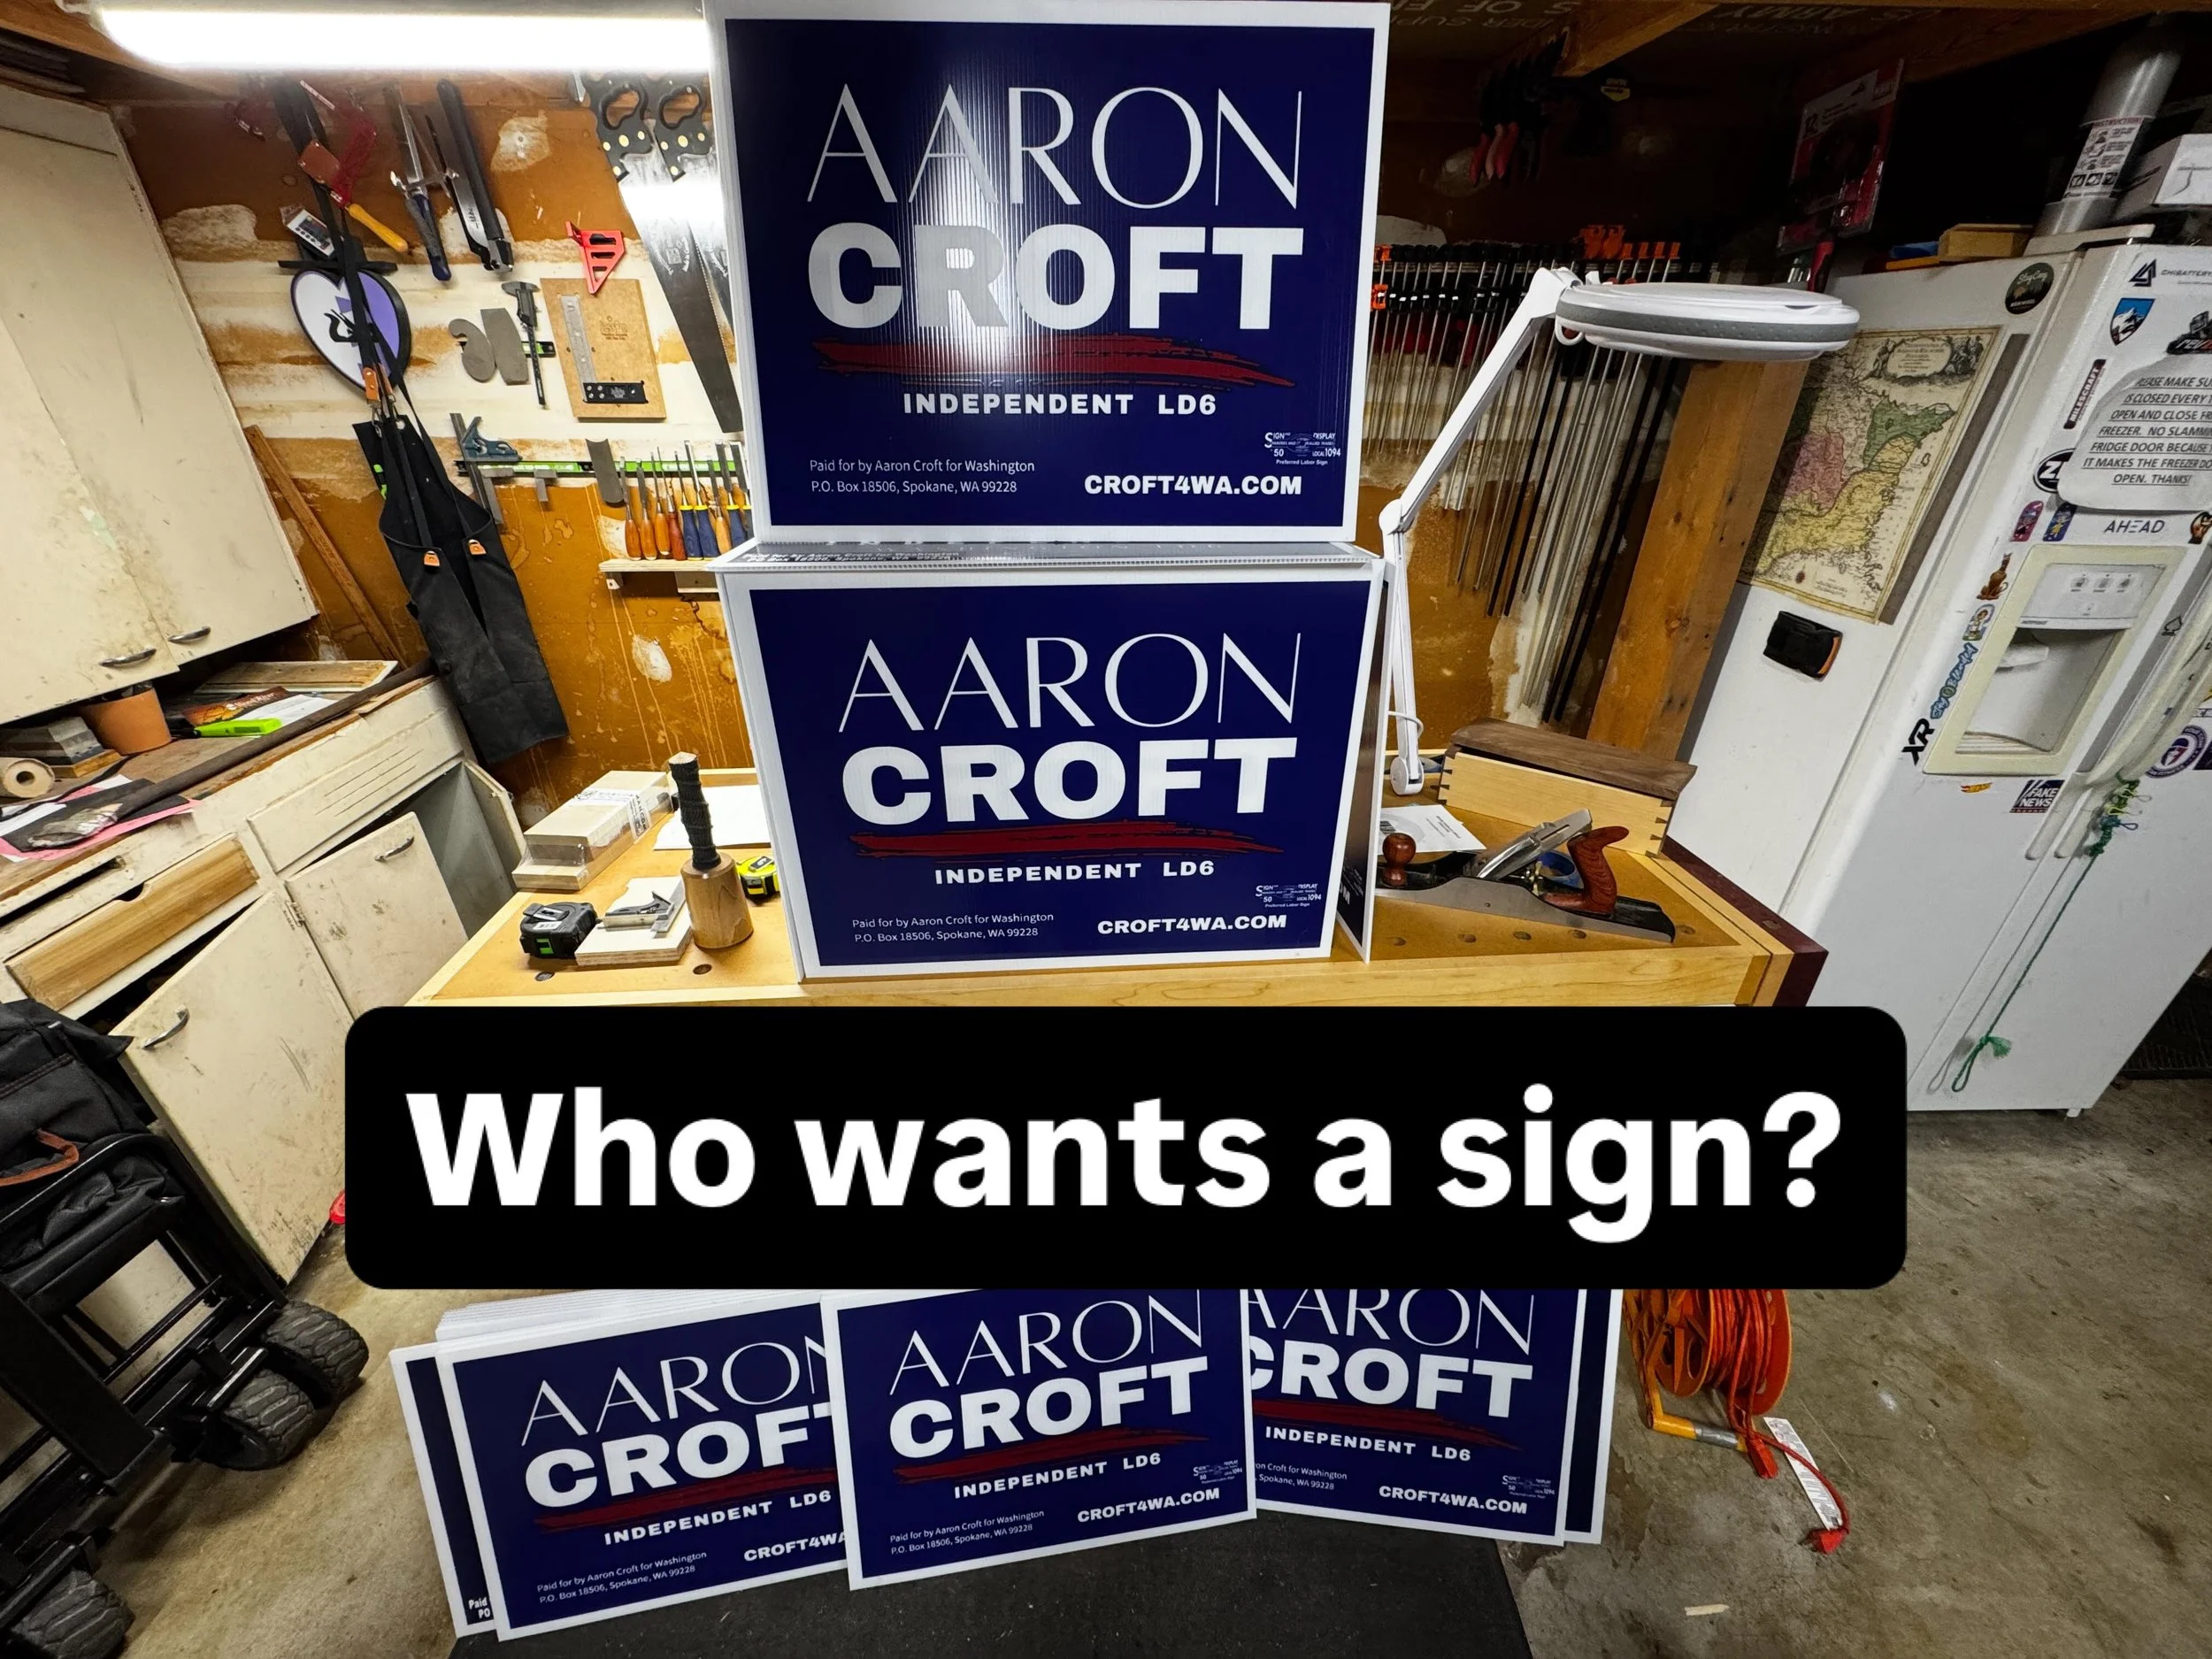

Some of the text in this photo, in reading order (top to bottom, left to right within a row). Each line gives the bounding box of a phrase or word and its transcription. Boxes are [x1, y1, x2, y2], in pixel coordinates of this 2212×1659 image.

[807, 83, 1302, 210] AARON
[808, 221, 1304, 330] CROFT
[2163, 377, 2194, 388] MAKE
[903, 390, 1217, 416] INDEPENDENT LD6
[2132, 394, 2170, 403] CLOSED
[2170, 394, 2206, 404] EVERY
[2110, 410, 2135, 420] OPEN
[2139, 410, 2161, 420] AND
[2162, 410, 2197, 420] CLOSE
[2099, 426, 2142, 436] FREEZER.
[2147, 426, 2166, 436] NO
[1273, 448, 1285, 457] 50
[1325, 448, 1341, 457] 1094
[2090, 442, 2127, 452] FRIDGE
[2130, 442, 2163, 452] DOOR
[2167, 442, 2208, 453] BECAUSE
[810, 458, 1035, 476] Paid for by Aaron Croft for Washington
[2083, 457, 2094, 467] IT
[2095, 457, 2134, 468] MAKES
[2138, 458, 2158, 468] THE
[2161, 458, 2198, 468] FREEZER
[811, 480, 1018, 495] P.O. Box 18506, Spokane, WA 99228
[1084, 474, 1302, 495] CROFT4WA.COM
[2113, 473, 2193, 485] OPEN. THANKS!
[2103, 519, 2166, 534] AHEAD
[838, 633, 1302, 733] AARON
[1901, 718, 1935, 766] XR
[842, 737, 1297, 826] CROFT
[2029, 787, 2059, 798] FAKE
[2019, 798, 2053, 807] NEWS
[934, 860, 1215, 885] INDEPENDENT LD6
[852, 912, 1054, 929] Paid for by Aaron Croft for Washington
[1097, 914, 1287, 935] CROFT4WA.COM
[854, 927, 1039, 942] P.O. Box 18506, Spokane, WA 99228
[889, 1289, 1202, 1395] AARON
[889, 1356, 1209, 1458] CROFT
[1265, 1425, 1471, 1462] INDEPENDENT LD6
[954, 1452, 1162, 1500] INDEPENDENT LD6
[1266, 1463, 1287, 1473] Croft
[1287, 1464, 1301, 1474] for
[1301, 1467, 1348, 1480] Washington
[1258, 1473, 1335, 1491] Spokane, WA 99228
[1077, 1486, 1220, 1523] CROFT4WA.COM
[1379, 1485, 1528, 1515] CROFT4WA.COM
[603, 1489, 832, 1546] INDEPENDENT LD6
[889, 1510, 1045, 1543] Paid for by Aaron Croft for Washington
[890, 1523, 1033, 1555] P.O. Box 18506, Spokane, WA 99228
[536, 1552, 708, 1593] Paid for by Aaron Croft for Washington
[539, 1564, 696, 1604] P.O. Box 18506, Spokane, WA 99228
[468, 1596, 488, 1609] Paid
[478, 1607, 491, 1619] PO
